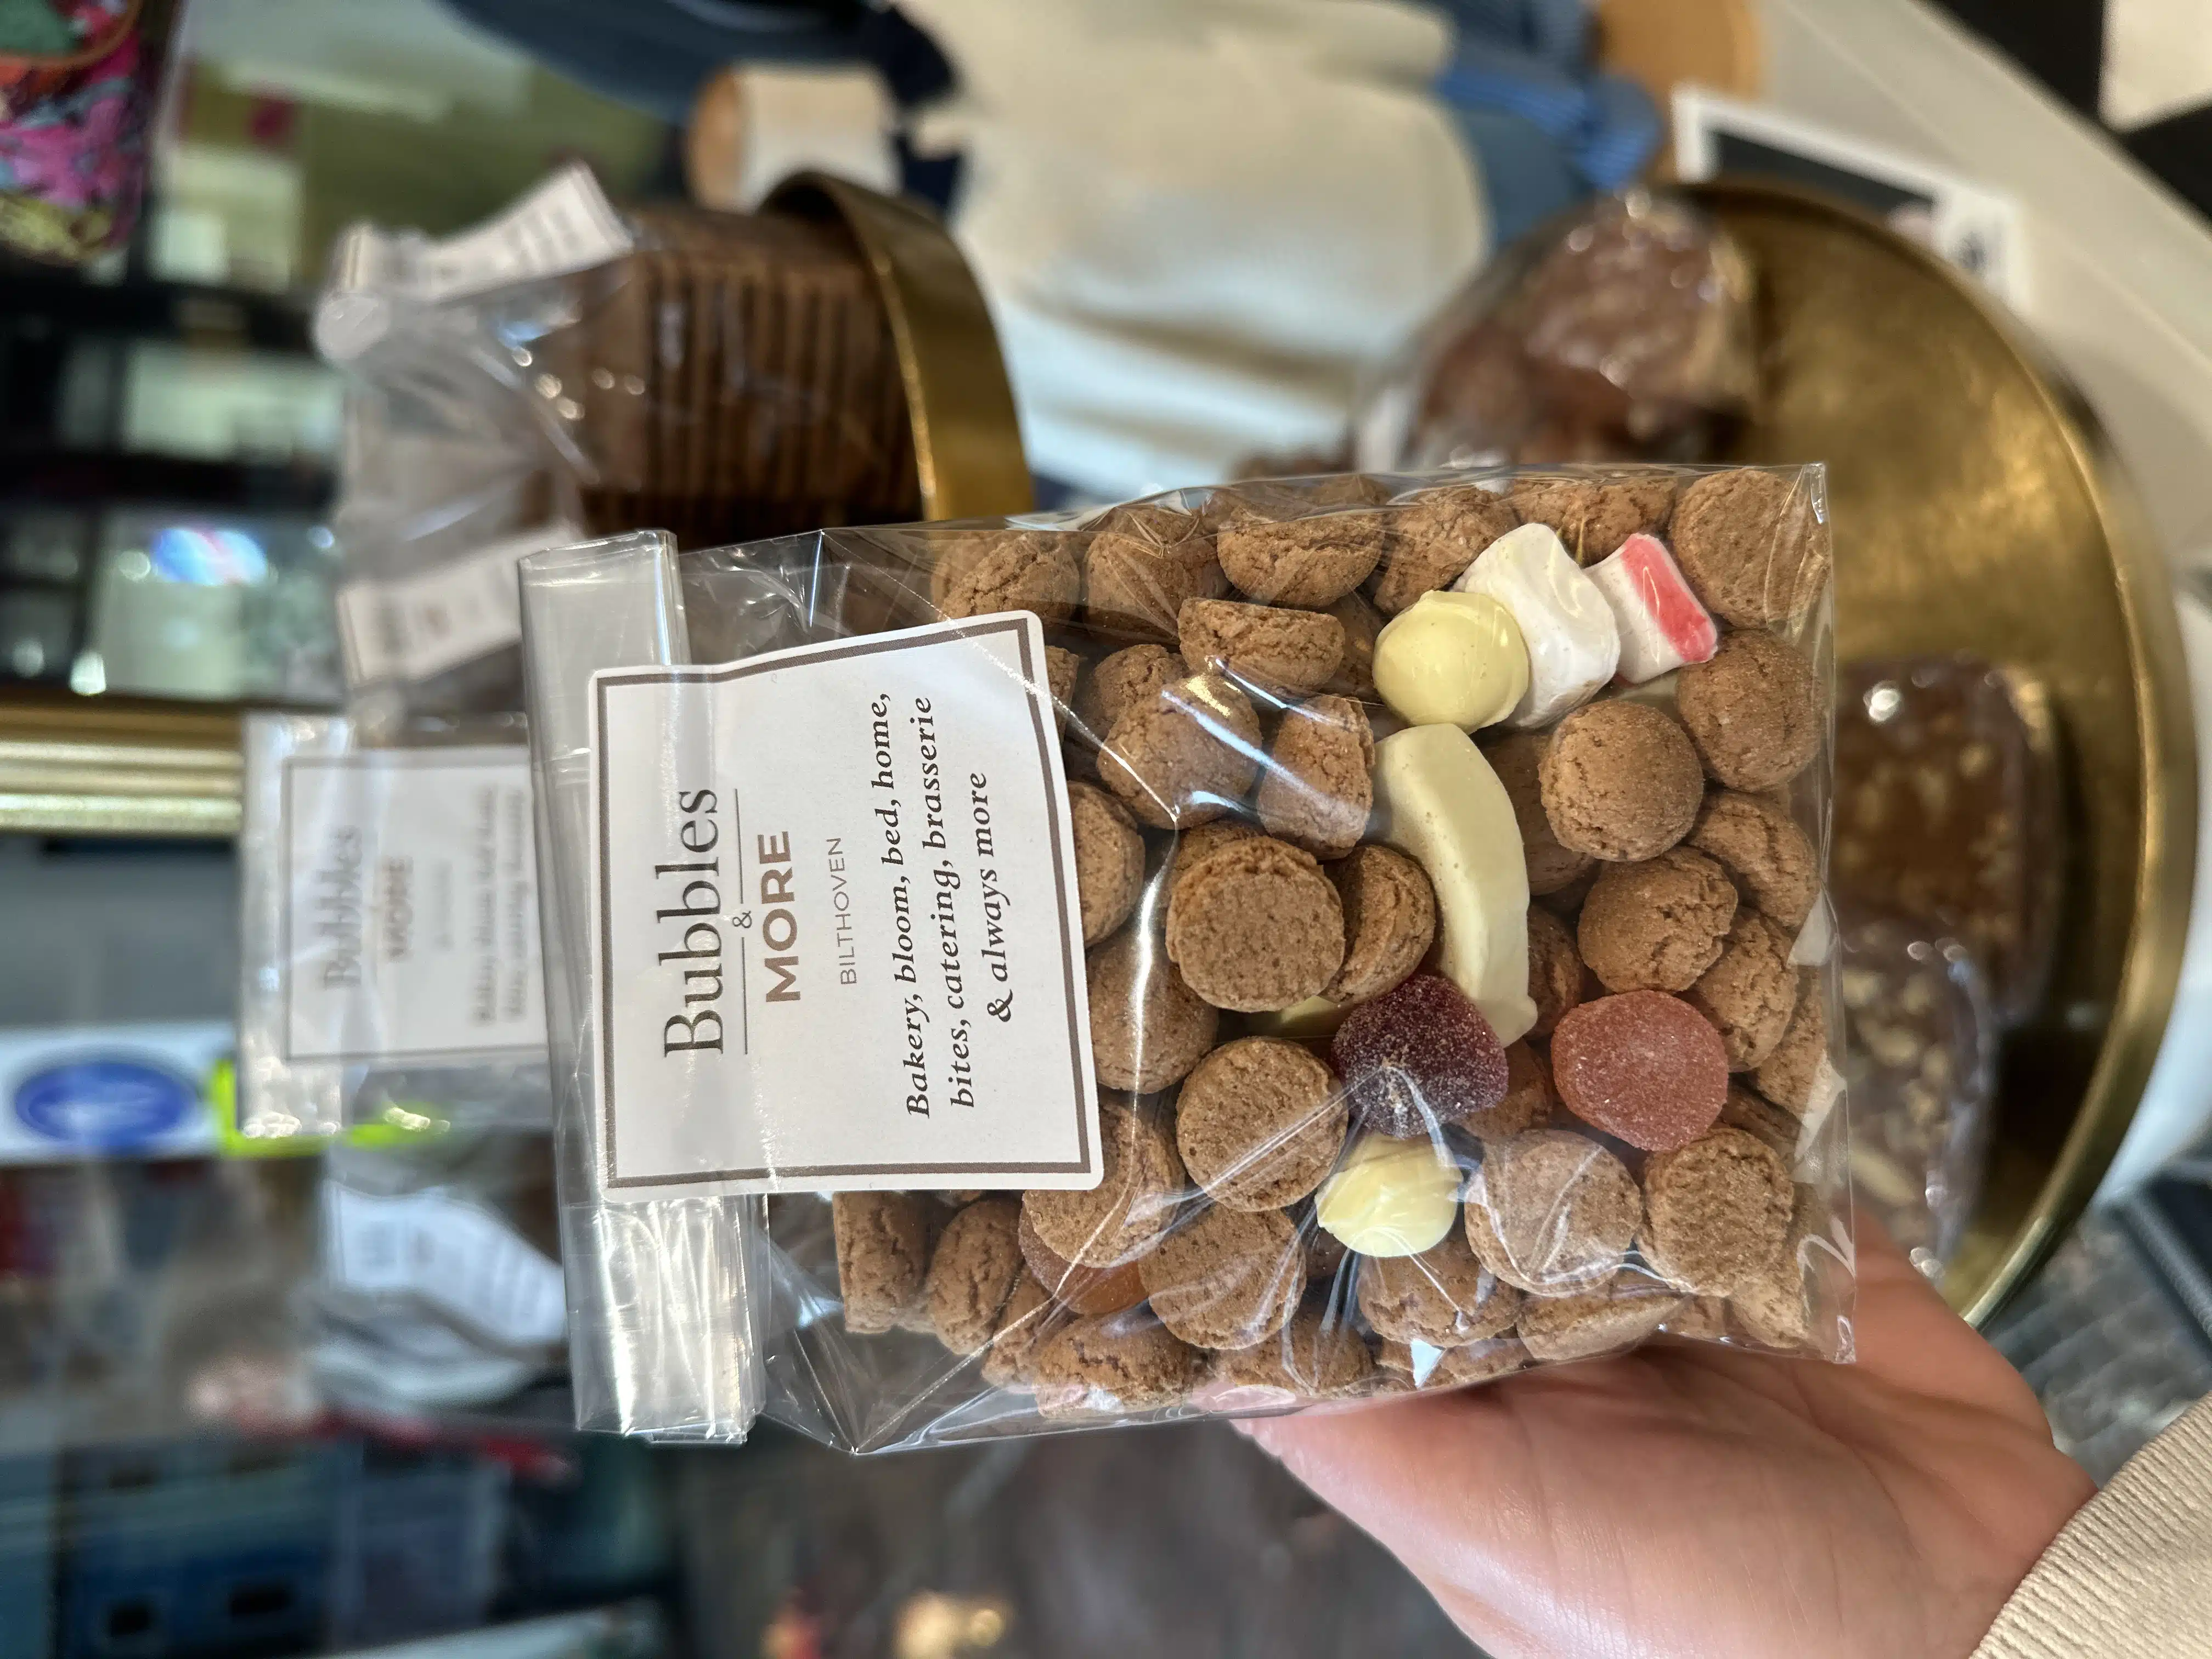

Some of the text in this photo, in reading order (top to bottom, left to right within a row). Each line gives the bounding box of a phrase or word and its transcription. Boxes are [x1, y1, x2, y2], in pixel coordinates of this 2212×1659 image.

[654, 789, 724, 1058] Bubbles
[732, 911, 752, 928] &
[758, 832, 800, 1002] MORE
[826, 838, 857, 984] BILTHOVEN
[871, 694, 930, 1119] Bakery, bloom, bed, home,
[910, 698, 974, 1108] bites, catering, brasserie
[970, 773, 1013, 1022] & always more
